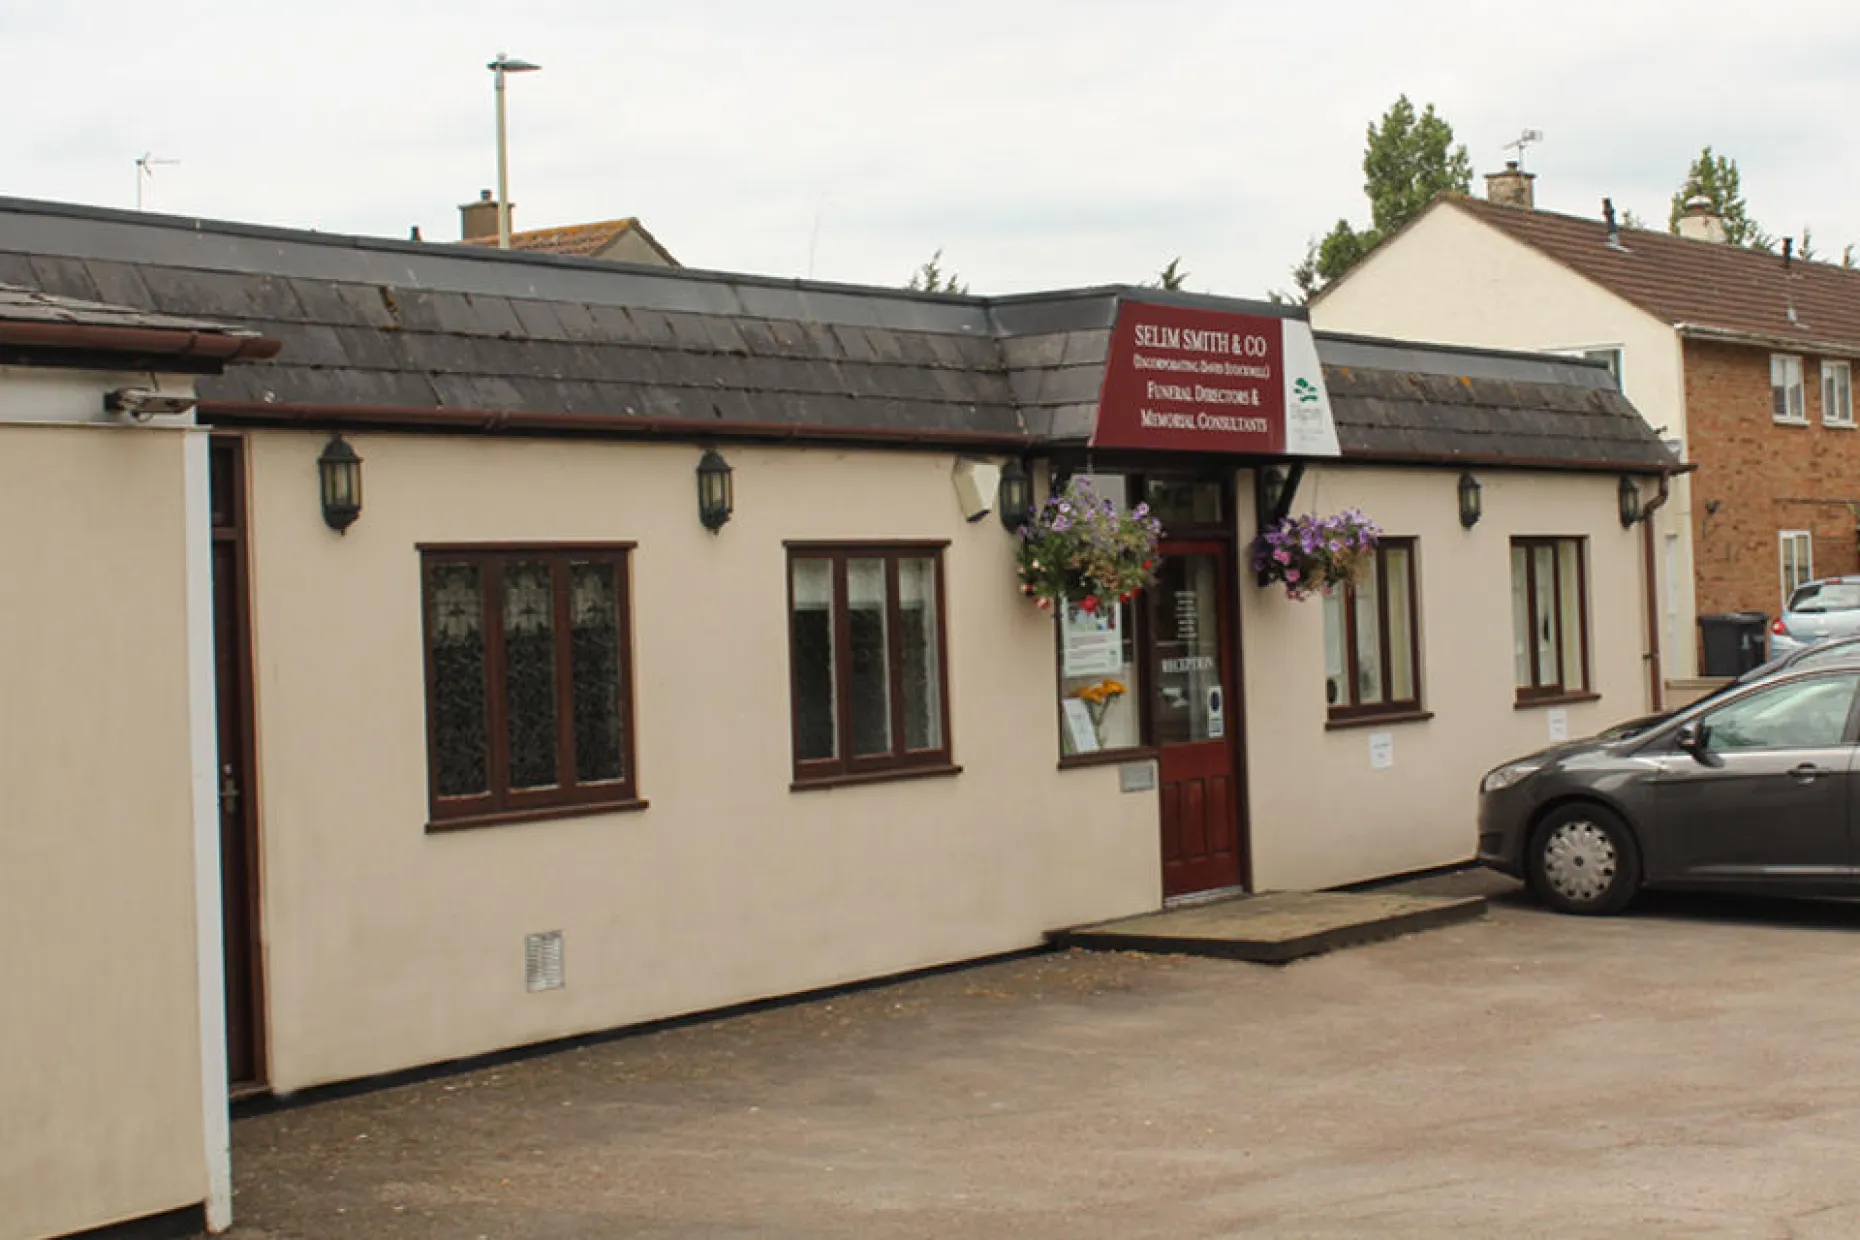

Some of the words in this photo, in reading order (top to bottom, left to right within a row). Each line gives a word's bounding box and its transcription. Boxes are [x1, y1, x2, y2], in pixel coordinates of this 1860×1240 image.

[1135, 324, 1181, 349] SELIM
[1183, 328, 1229, 353] SMITH
[1231, 333, 1242, 355] &
[1244, 334, 1267, 357] CO
[1251, 387, 1260, 406] &
